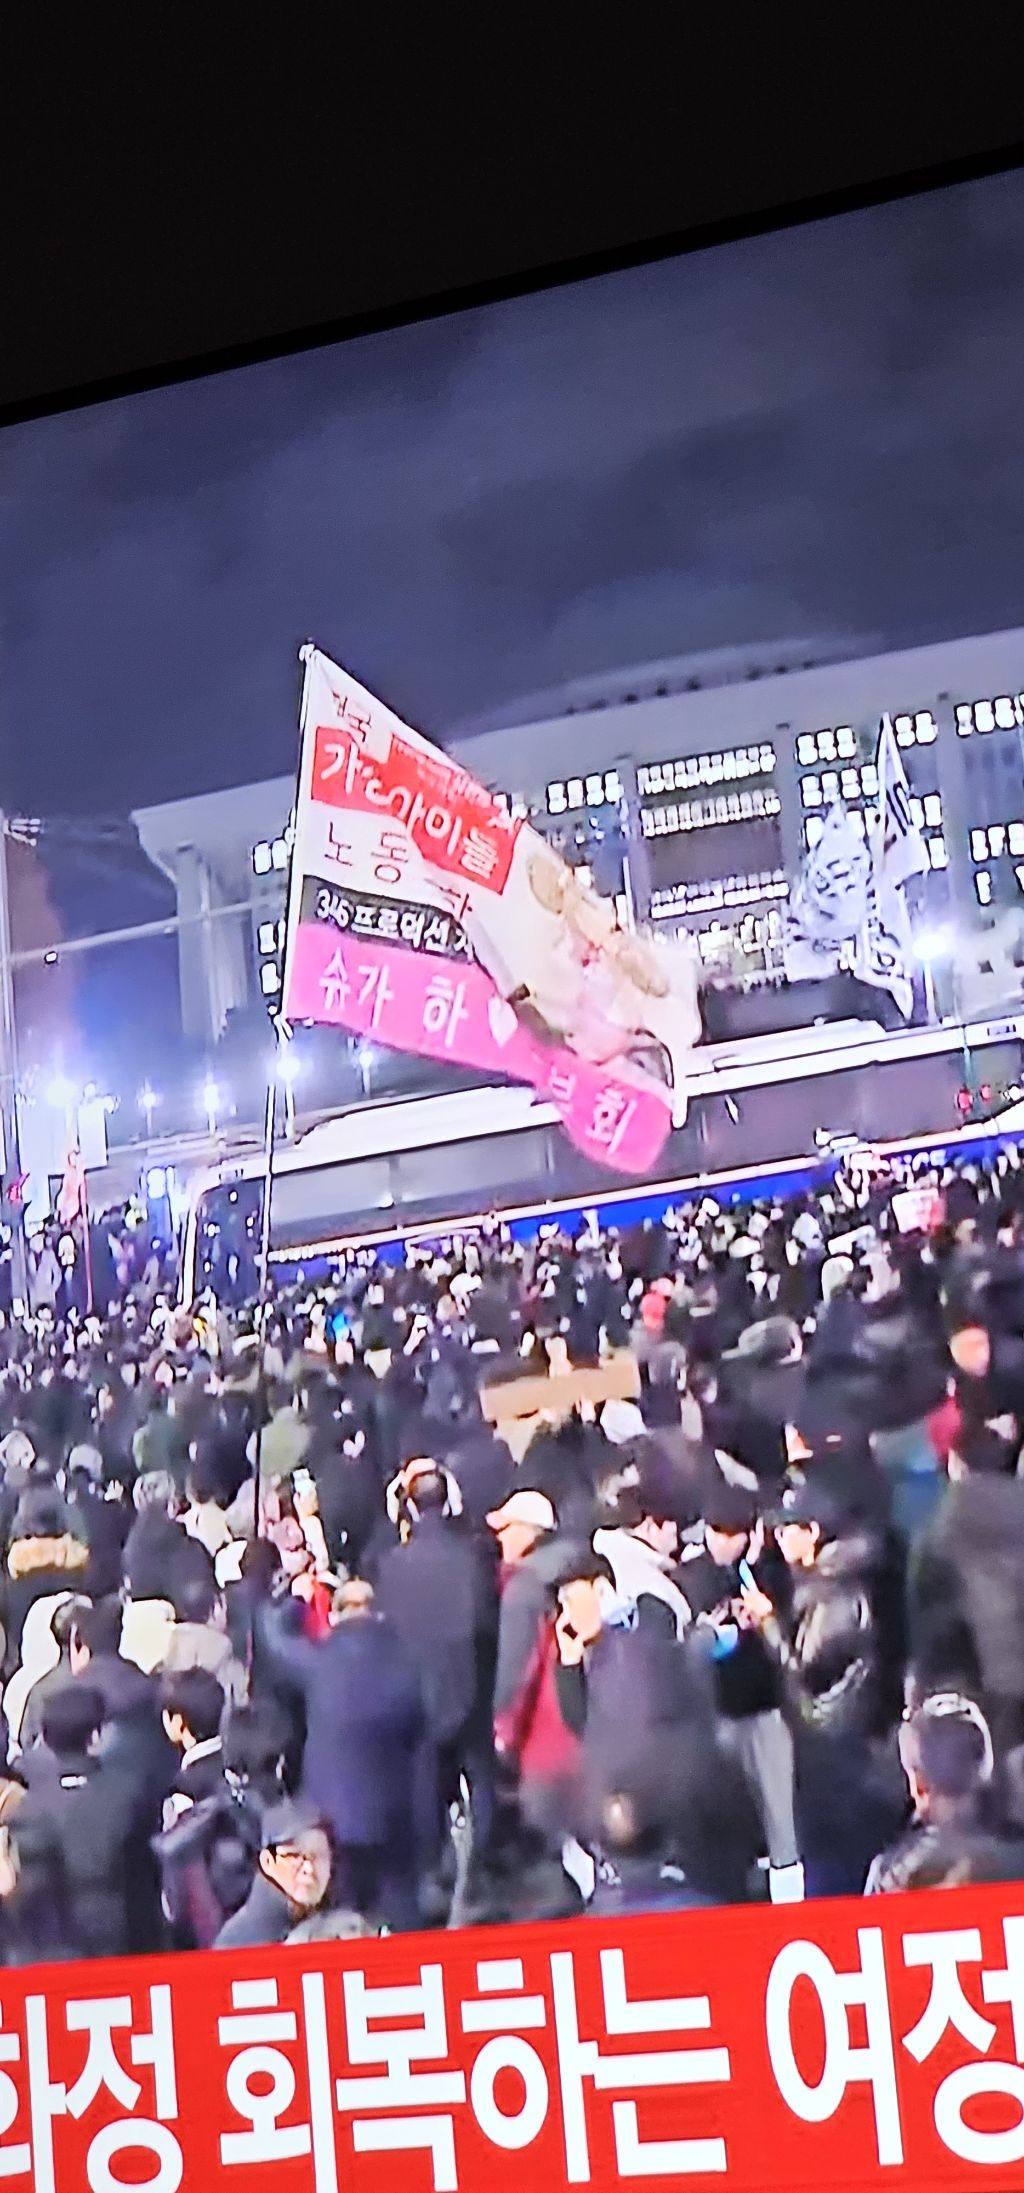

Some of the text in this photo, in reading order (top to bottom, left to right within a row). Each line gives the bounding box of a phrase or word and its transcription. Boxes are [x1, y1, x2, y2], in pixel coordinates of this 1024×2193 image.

[319, 947, 395, 1030] 슈가
[217, 1948, 731, 2193] 회복하는
[765, 1915, 1024, 2165] 여정
